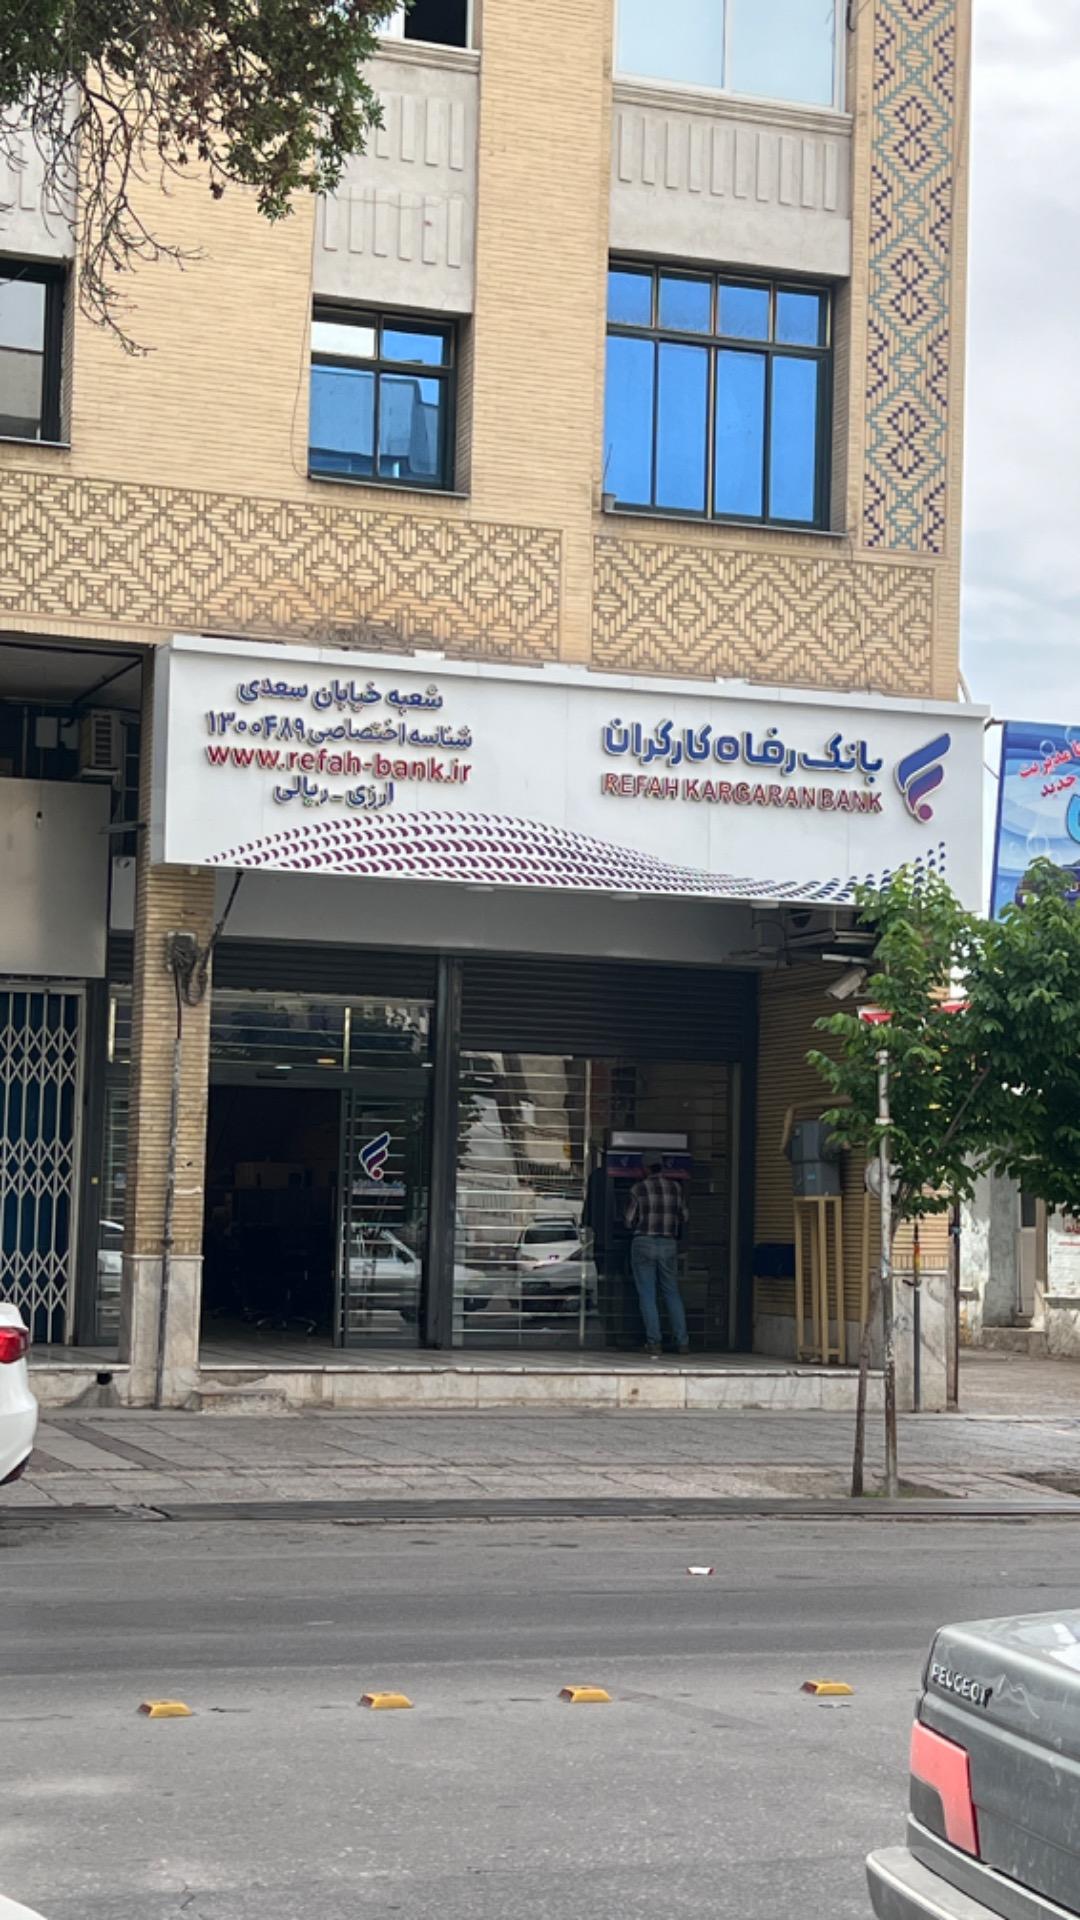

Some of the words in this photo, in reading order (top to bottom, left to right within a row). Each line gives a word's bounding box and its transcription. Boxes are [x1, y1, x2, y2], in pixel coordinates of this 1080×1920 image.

[237, 677, 309, 705] سعدی
[311, 679, 382, 711] خیابان
[385, 684, 444, 717] شعبه
[306, 718, 406, 749] اختصاصی
[408, 725, 474, 751] شناسه
[601, 718, 713, 768] کارگران
[714, 727, 799, 776] رفاه
[206, 744, 473, 784] www.refah-bank.ir
[801, 732, 884, 785] بانک
[600, 772, 680, 802] REFAH
[682, 778, 816, 809] KARGARAN
[817, 788, 884, 814] BANK
